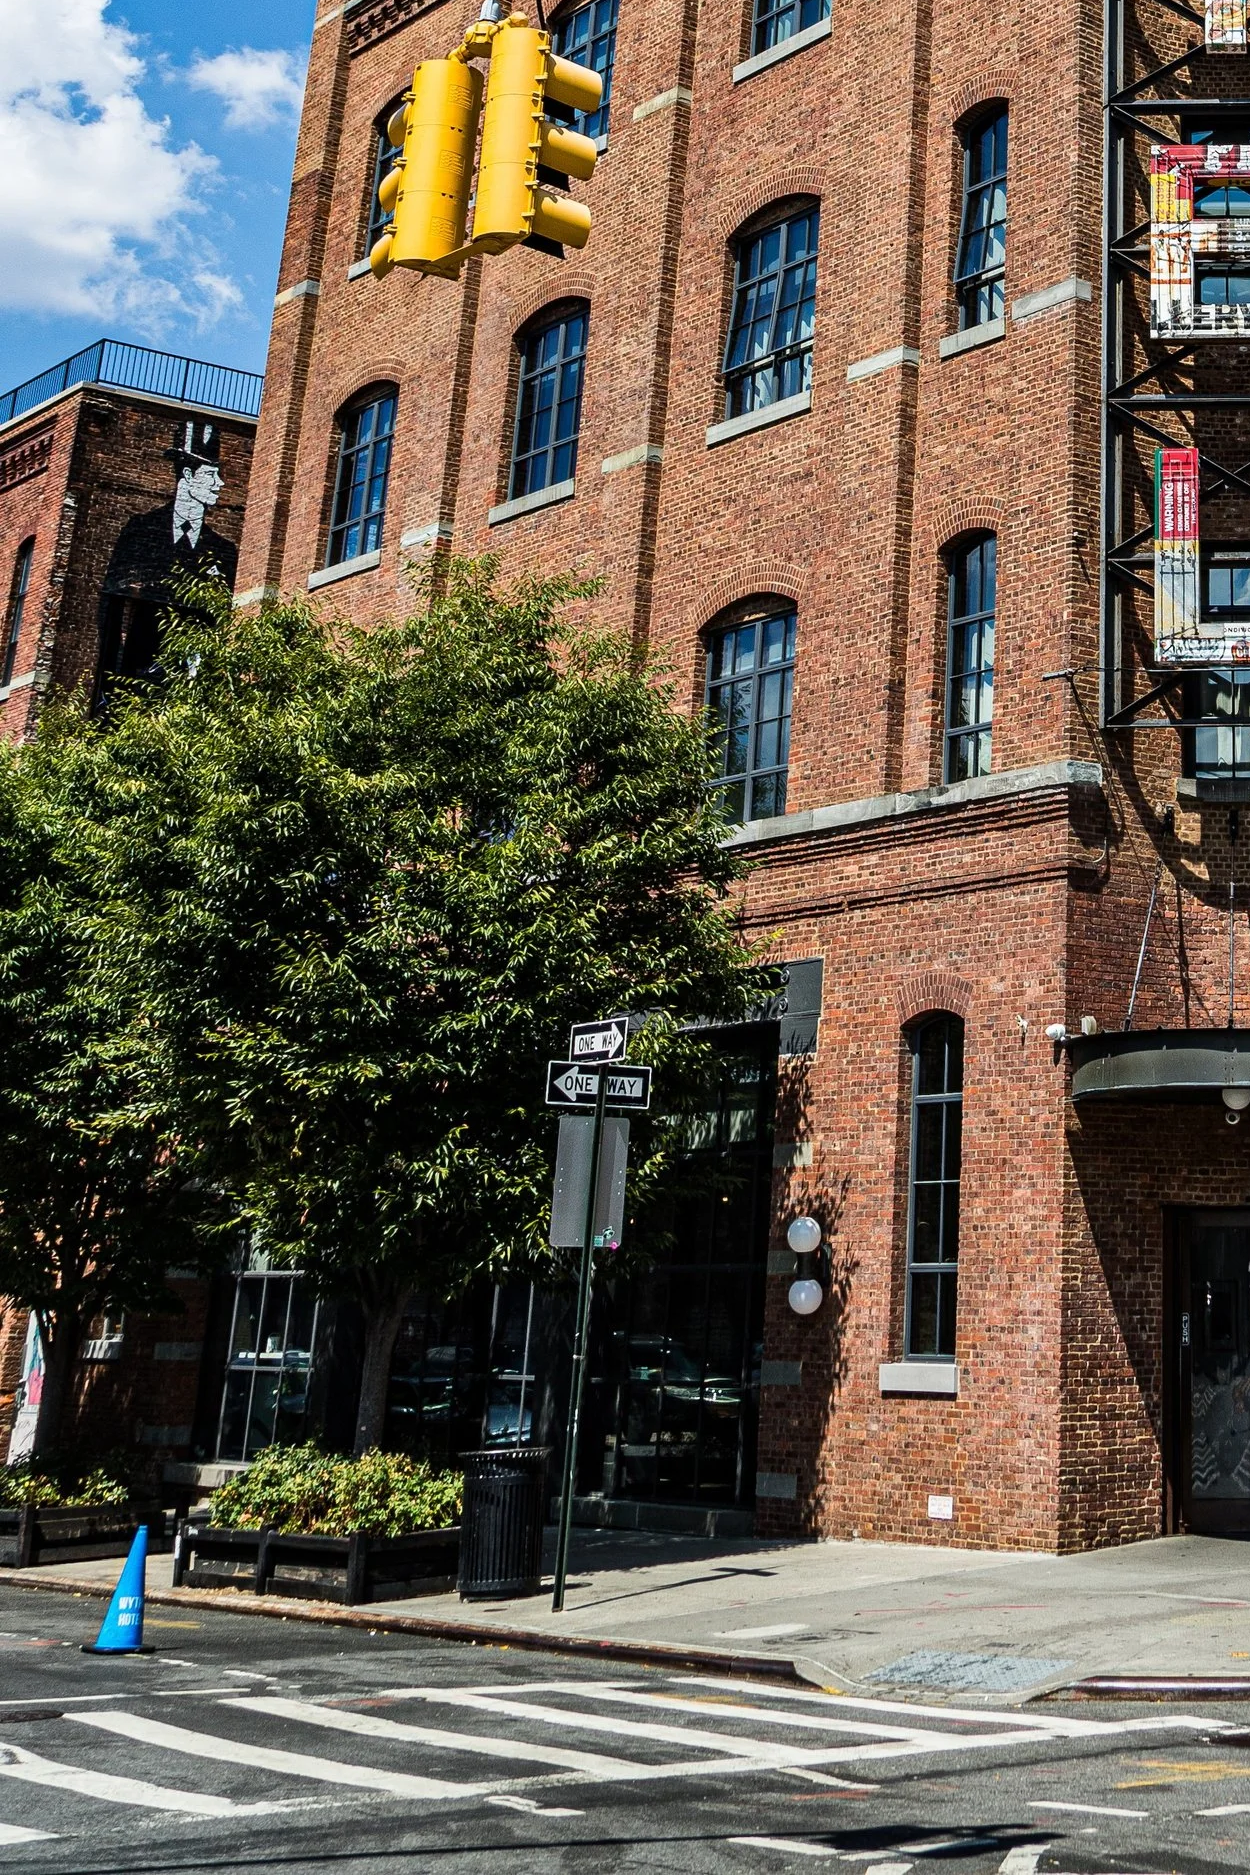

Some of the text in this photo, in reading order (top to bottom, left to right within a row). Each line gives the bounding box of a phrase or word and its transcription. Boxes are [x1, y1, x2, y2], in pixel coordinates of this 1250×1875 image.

[1183, 482, 1191, 495] OFF
[1163, 482, 1174, 532] WARNING
[578, 1032, 618, 1052] ONE WAY
[564, 1075, 637, 1095] ONE WAY
